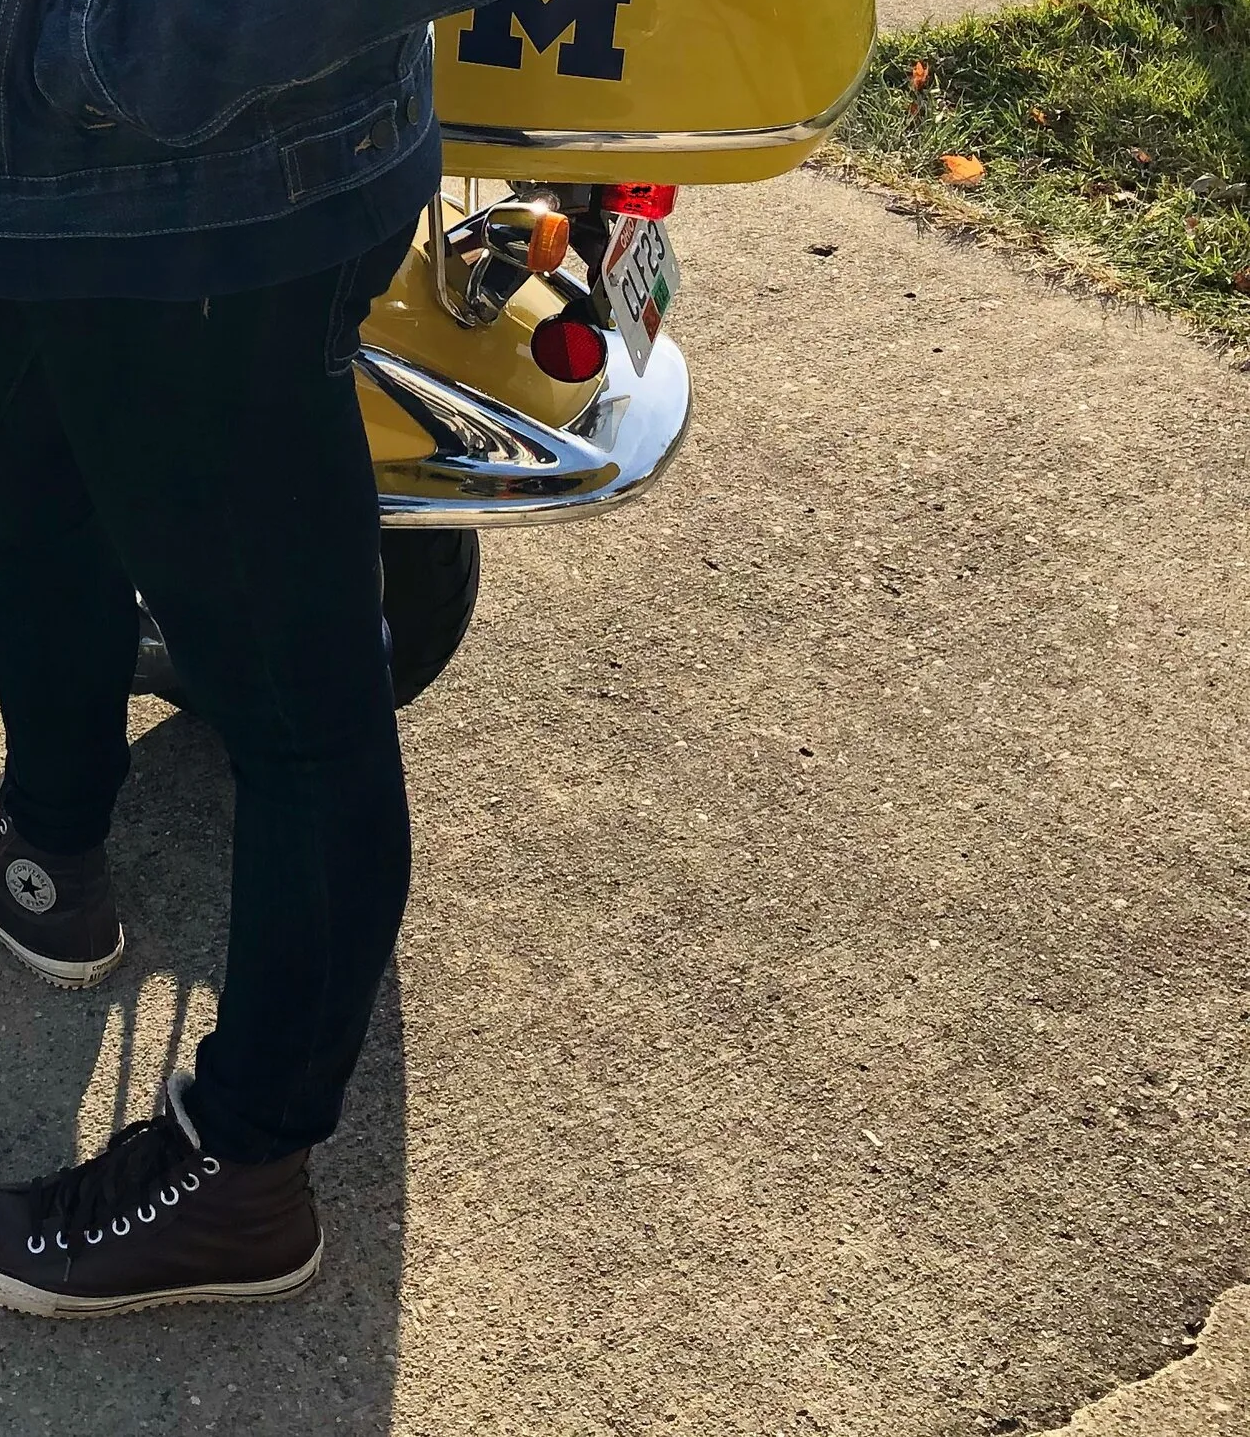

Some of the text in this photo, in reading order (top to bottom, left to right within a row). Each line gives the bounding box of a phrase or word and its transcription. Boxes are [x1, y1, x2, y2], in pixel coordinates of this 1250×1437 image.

[620, 218, 634, 248] OHIO
[621, 220, 666, 323] CLF23
[13, 865, 47, 887] CONVERSE
